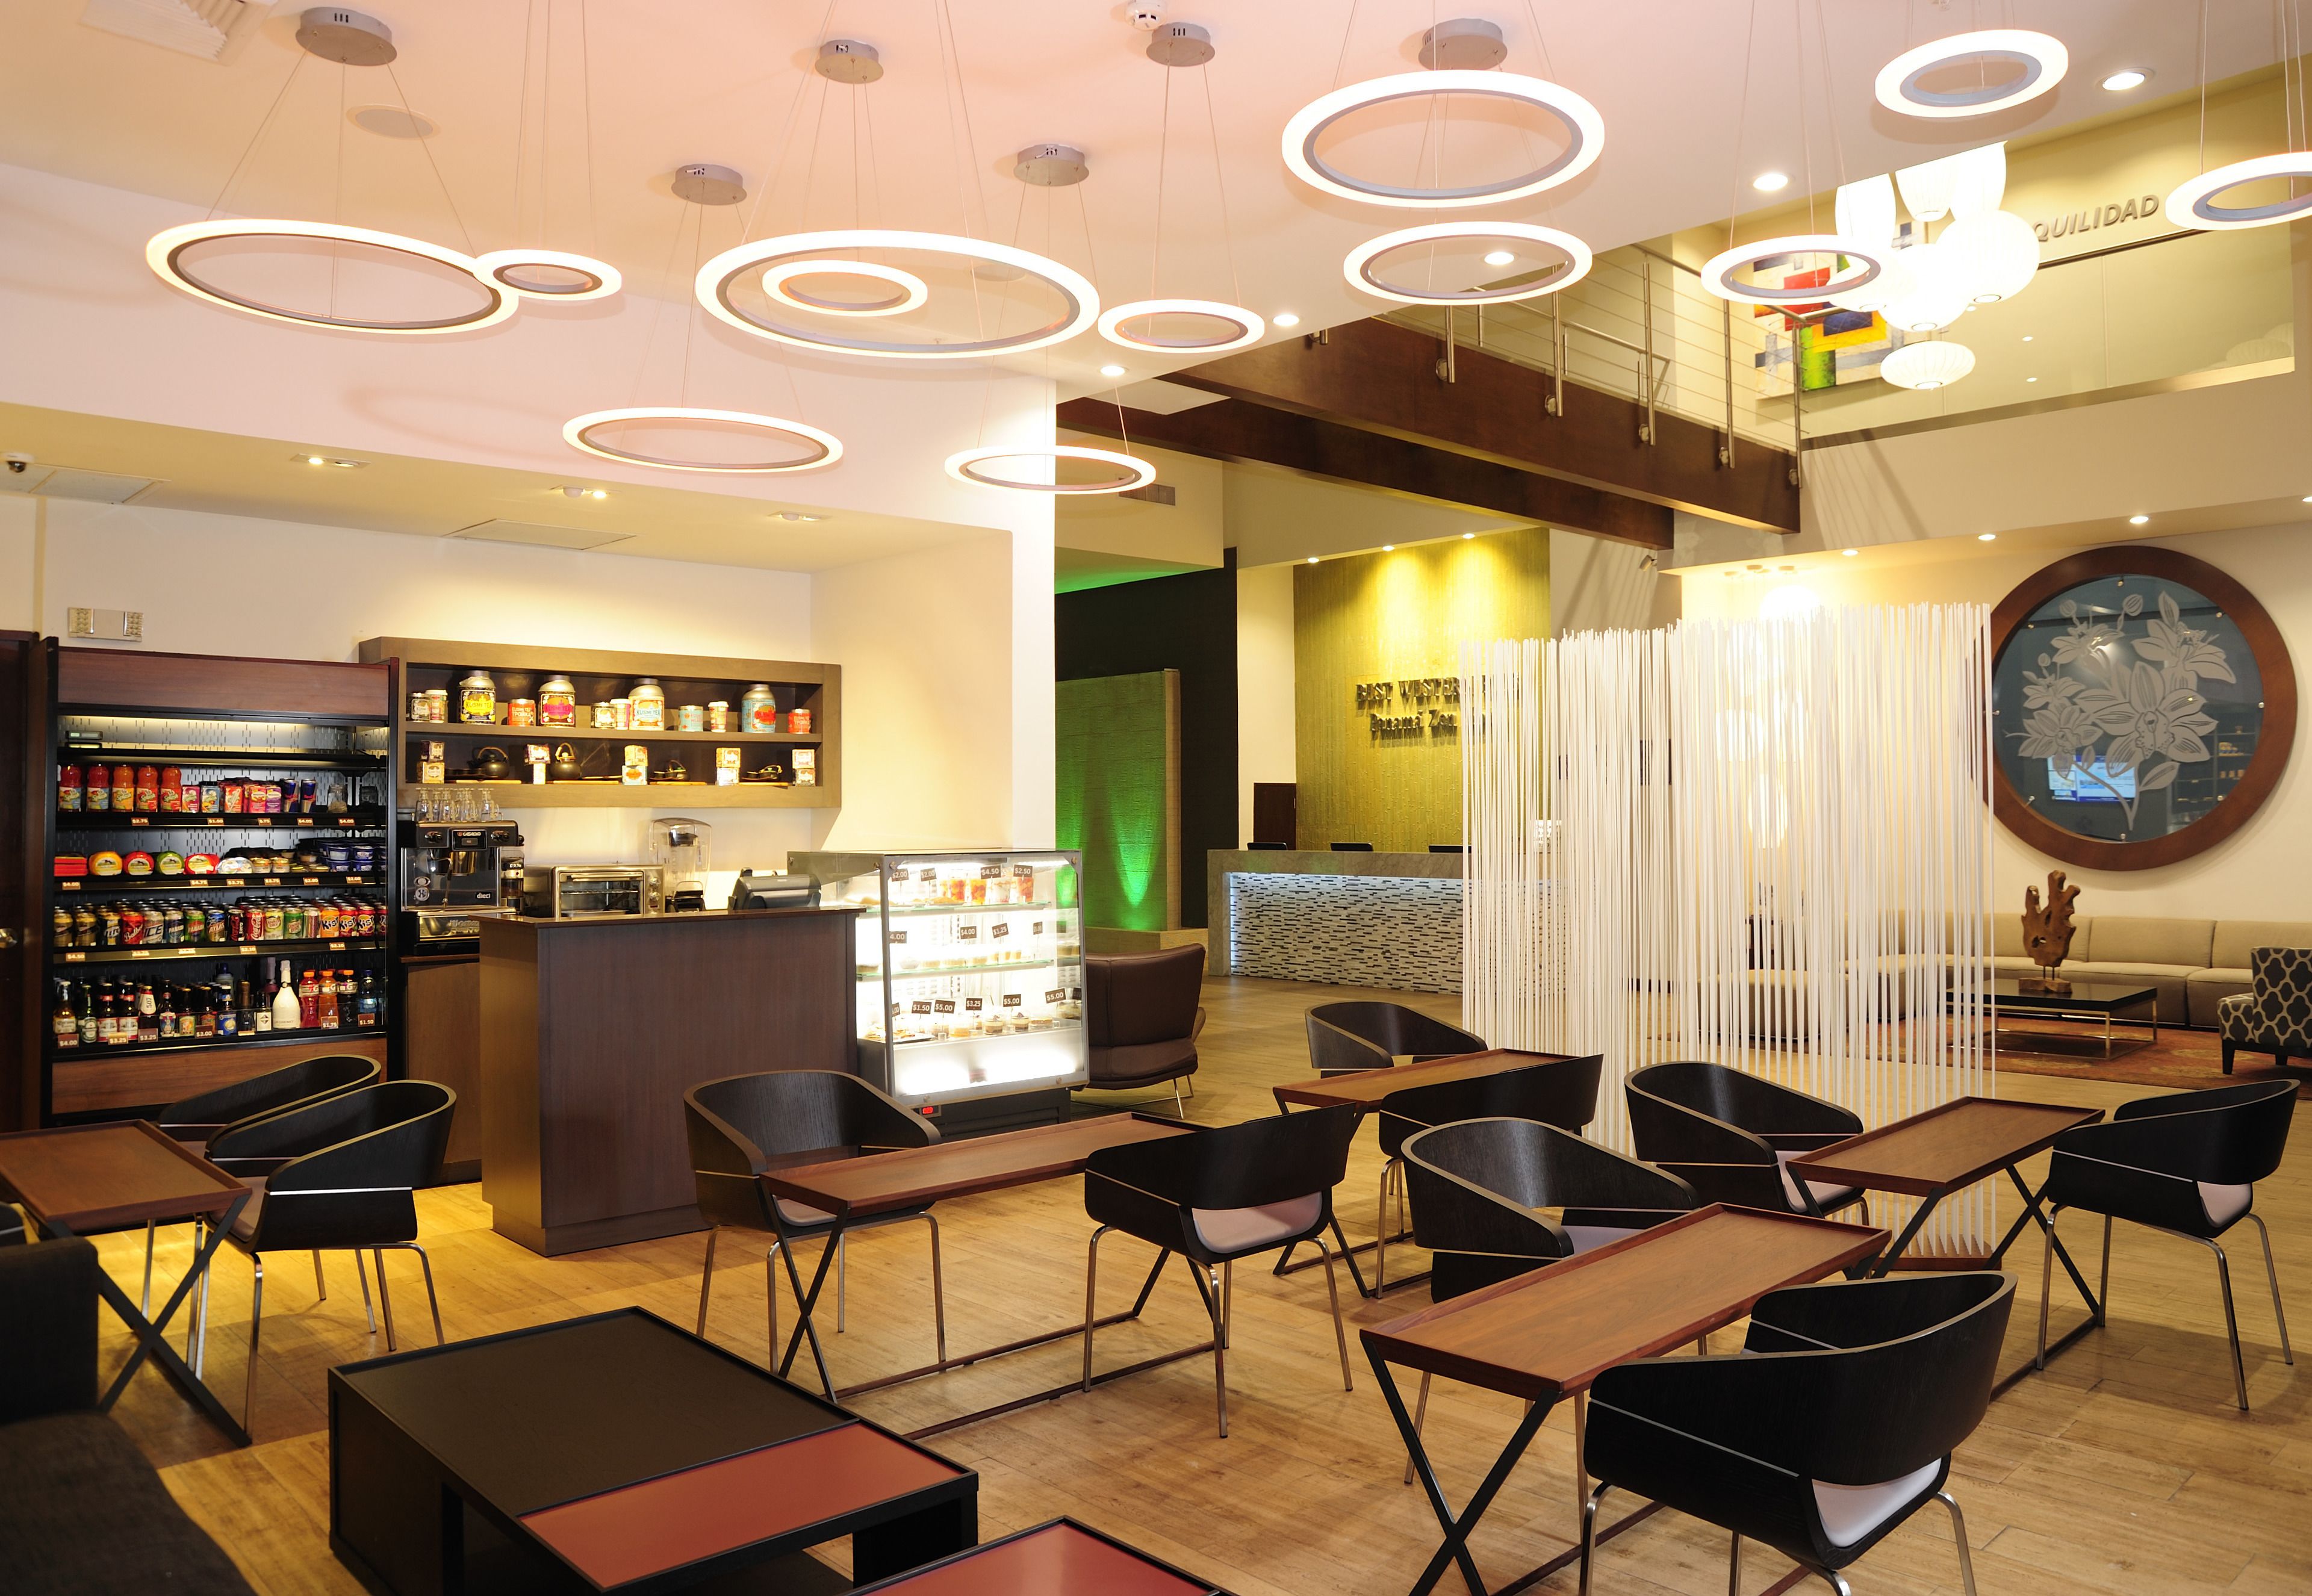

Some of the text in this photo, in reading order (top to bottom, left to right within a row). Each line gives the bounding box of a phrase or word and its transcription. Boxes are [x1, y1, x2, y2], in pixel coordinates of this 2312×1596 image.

[2033, 194, 2159, 242] QUILIDAD
[1398, 677, 1462, 698] WESTER
[145, 925, 163, 937] ICE
[993, 926, 1007, 935] $1.25
[1046, 992, 1064, 1001] $5.00
